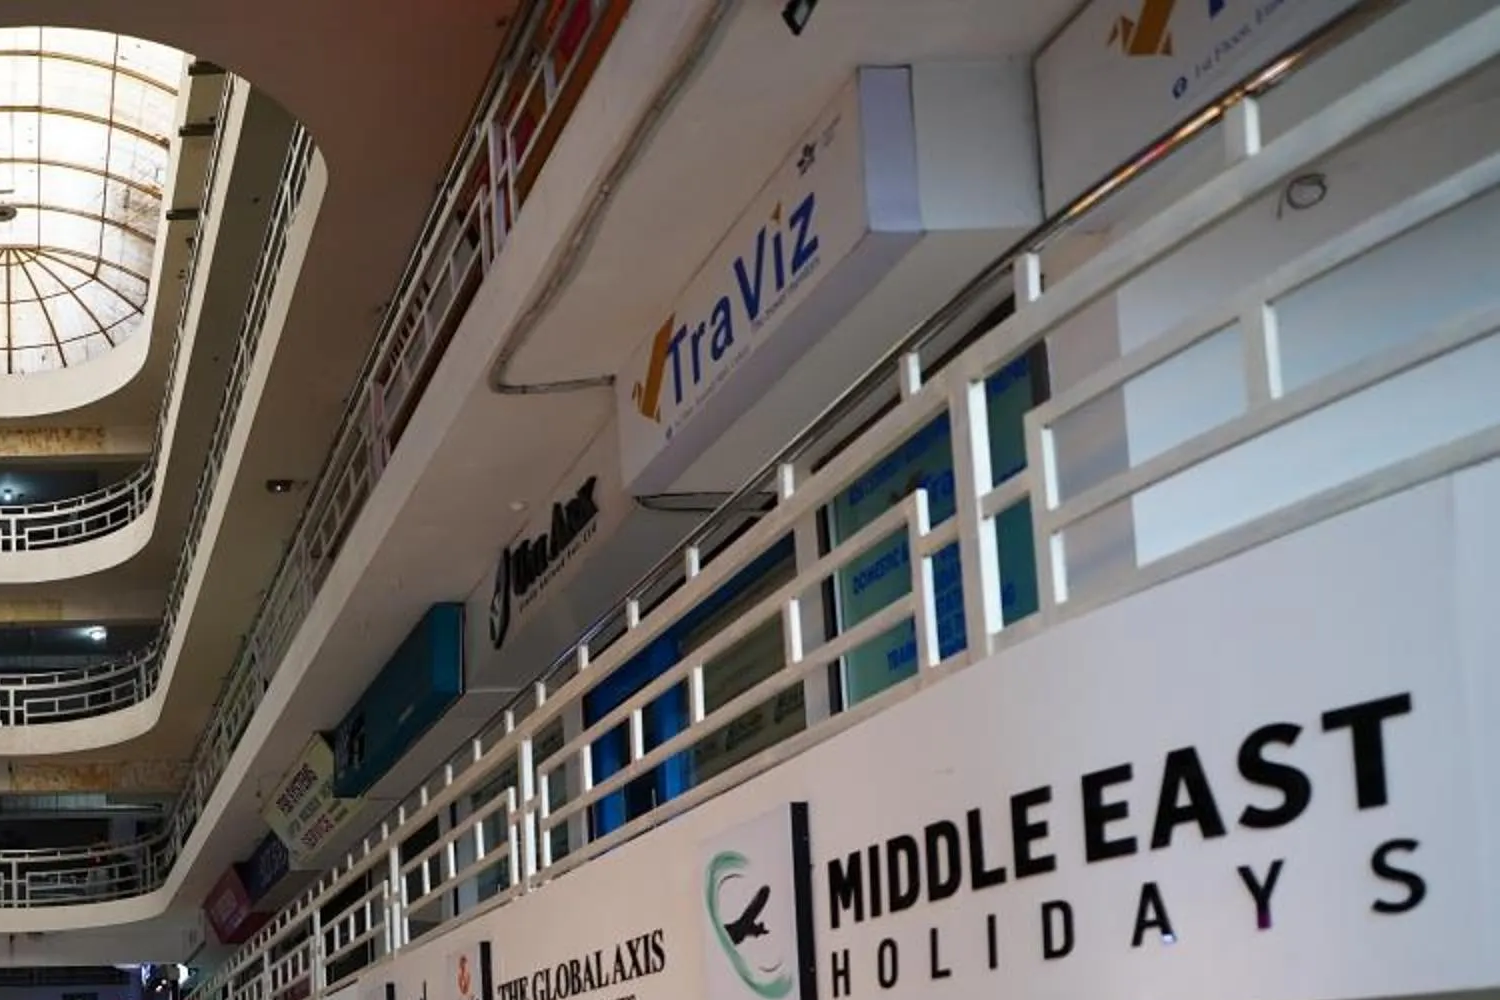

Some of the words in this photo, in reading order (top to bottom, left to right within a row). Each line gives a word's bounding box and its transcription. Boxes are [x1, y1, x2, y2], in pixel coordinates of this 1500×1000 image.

[666, 192, 819, 405] TraViz
[828, 787, 1056, 929] MIDDLE
[1081, 691, 1413, 865] EAST
[611, 928, 666, 985] AXIS
[832, 838, 1428, 999] HOLIDAYS
